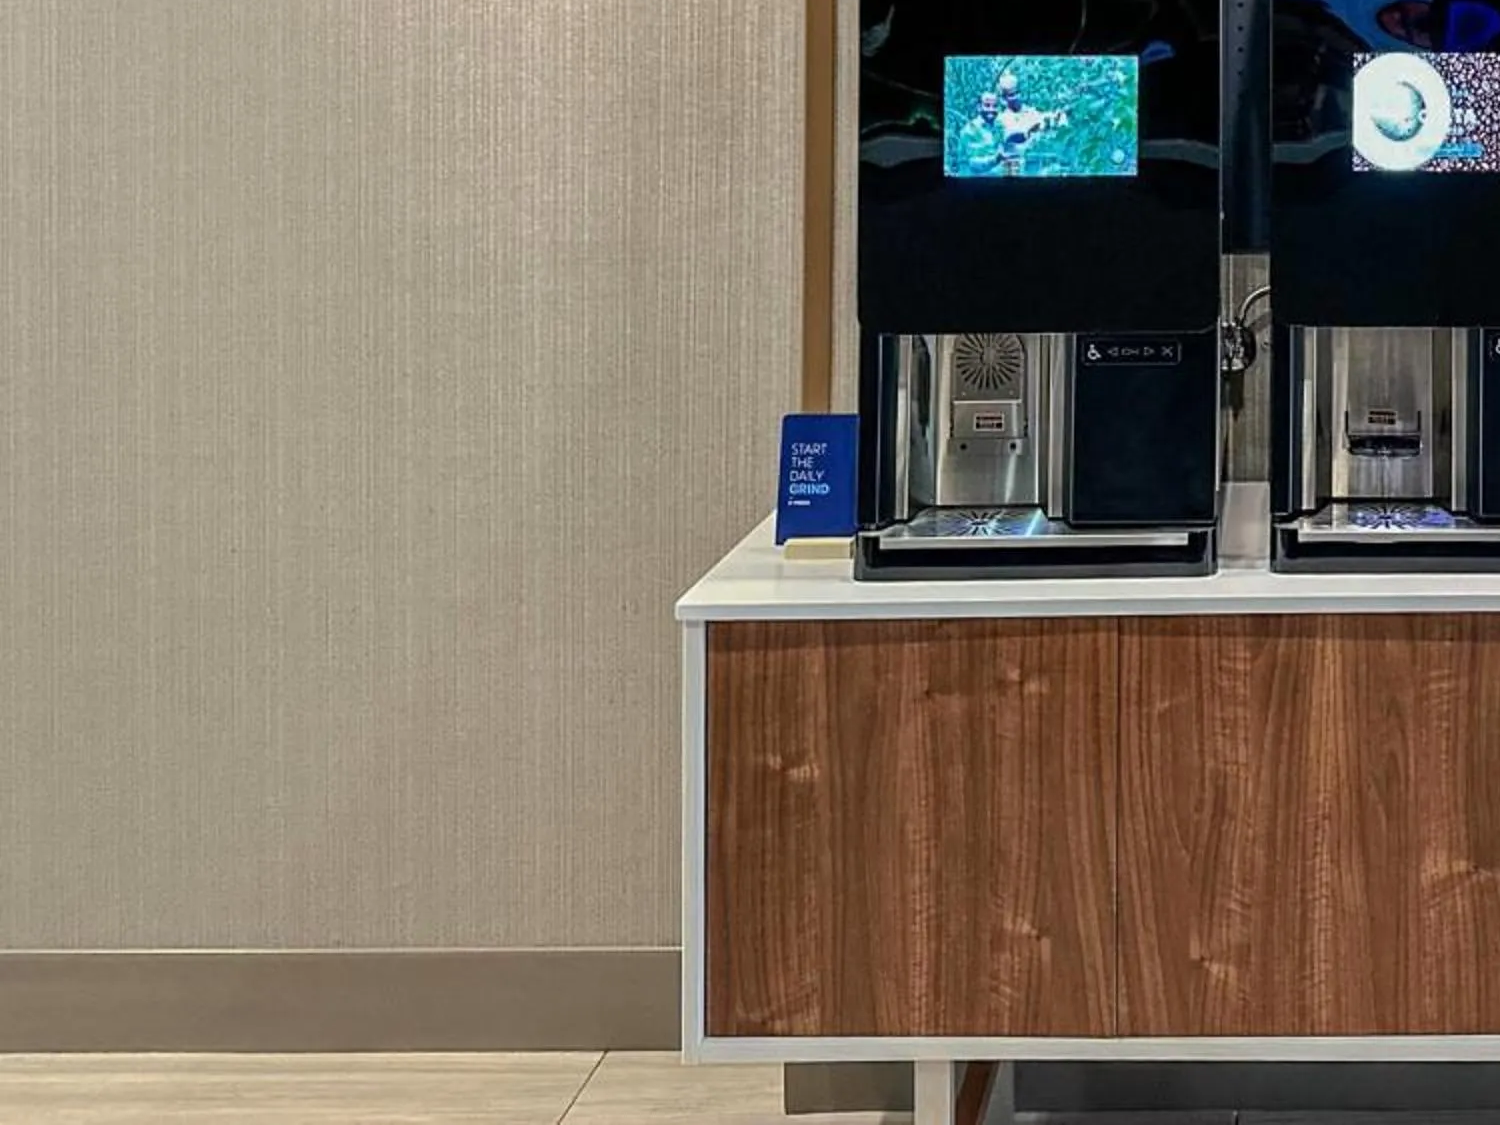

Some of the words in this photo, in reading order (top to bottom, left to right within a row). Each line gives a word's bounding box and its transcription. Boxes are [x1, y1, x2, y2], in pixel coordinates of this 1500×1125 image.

[790, 442, 829, 455] START
[790, 456, 815, 469] THE
[789, 470, 825, 482] DAILY
[788, 483, 831, 495] GRIND
